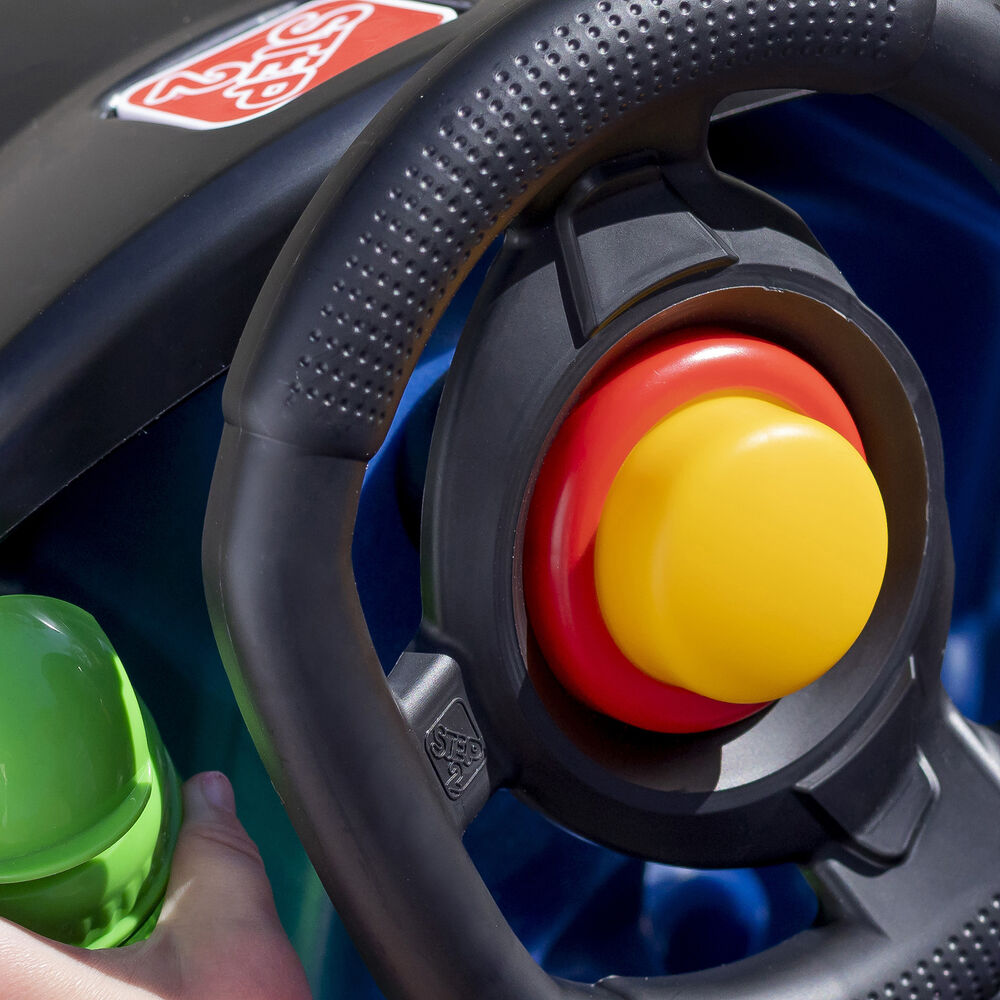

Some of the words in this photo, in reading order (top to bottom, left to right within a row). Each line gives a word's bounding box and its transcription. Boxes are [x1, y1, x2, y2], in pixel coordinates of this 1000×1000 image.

[223, 2, 375, 110] STEP
[143, 60, 252, 106] 2
[430, 724, 484, 766] STEP
[444, 760, 464, 789] 2
